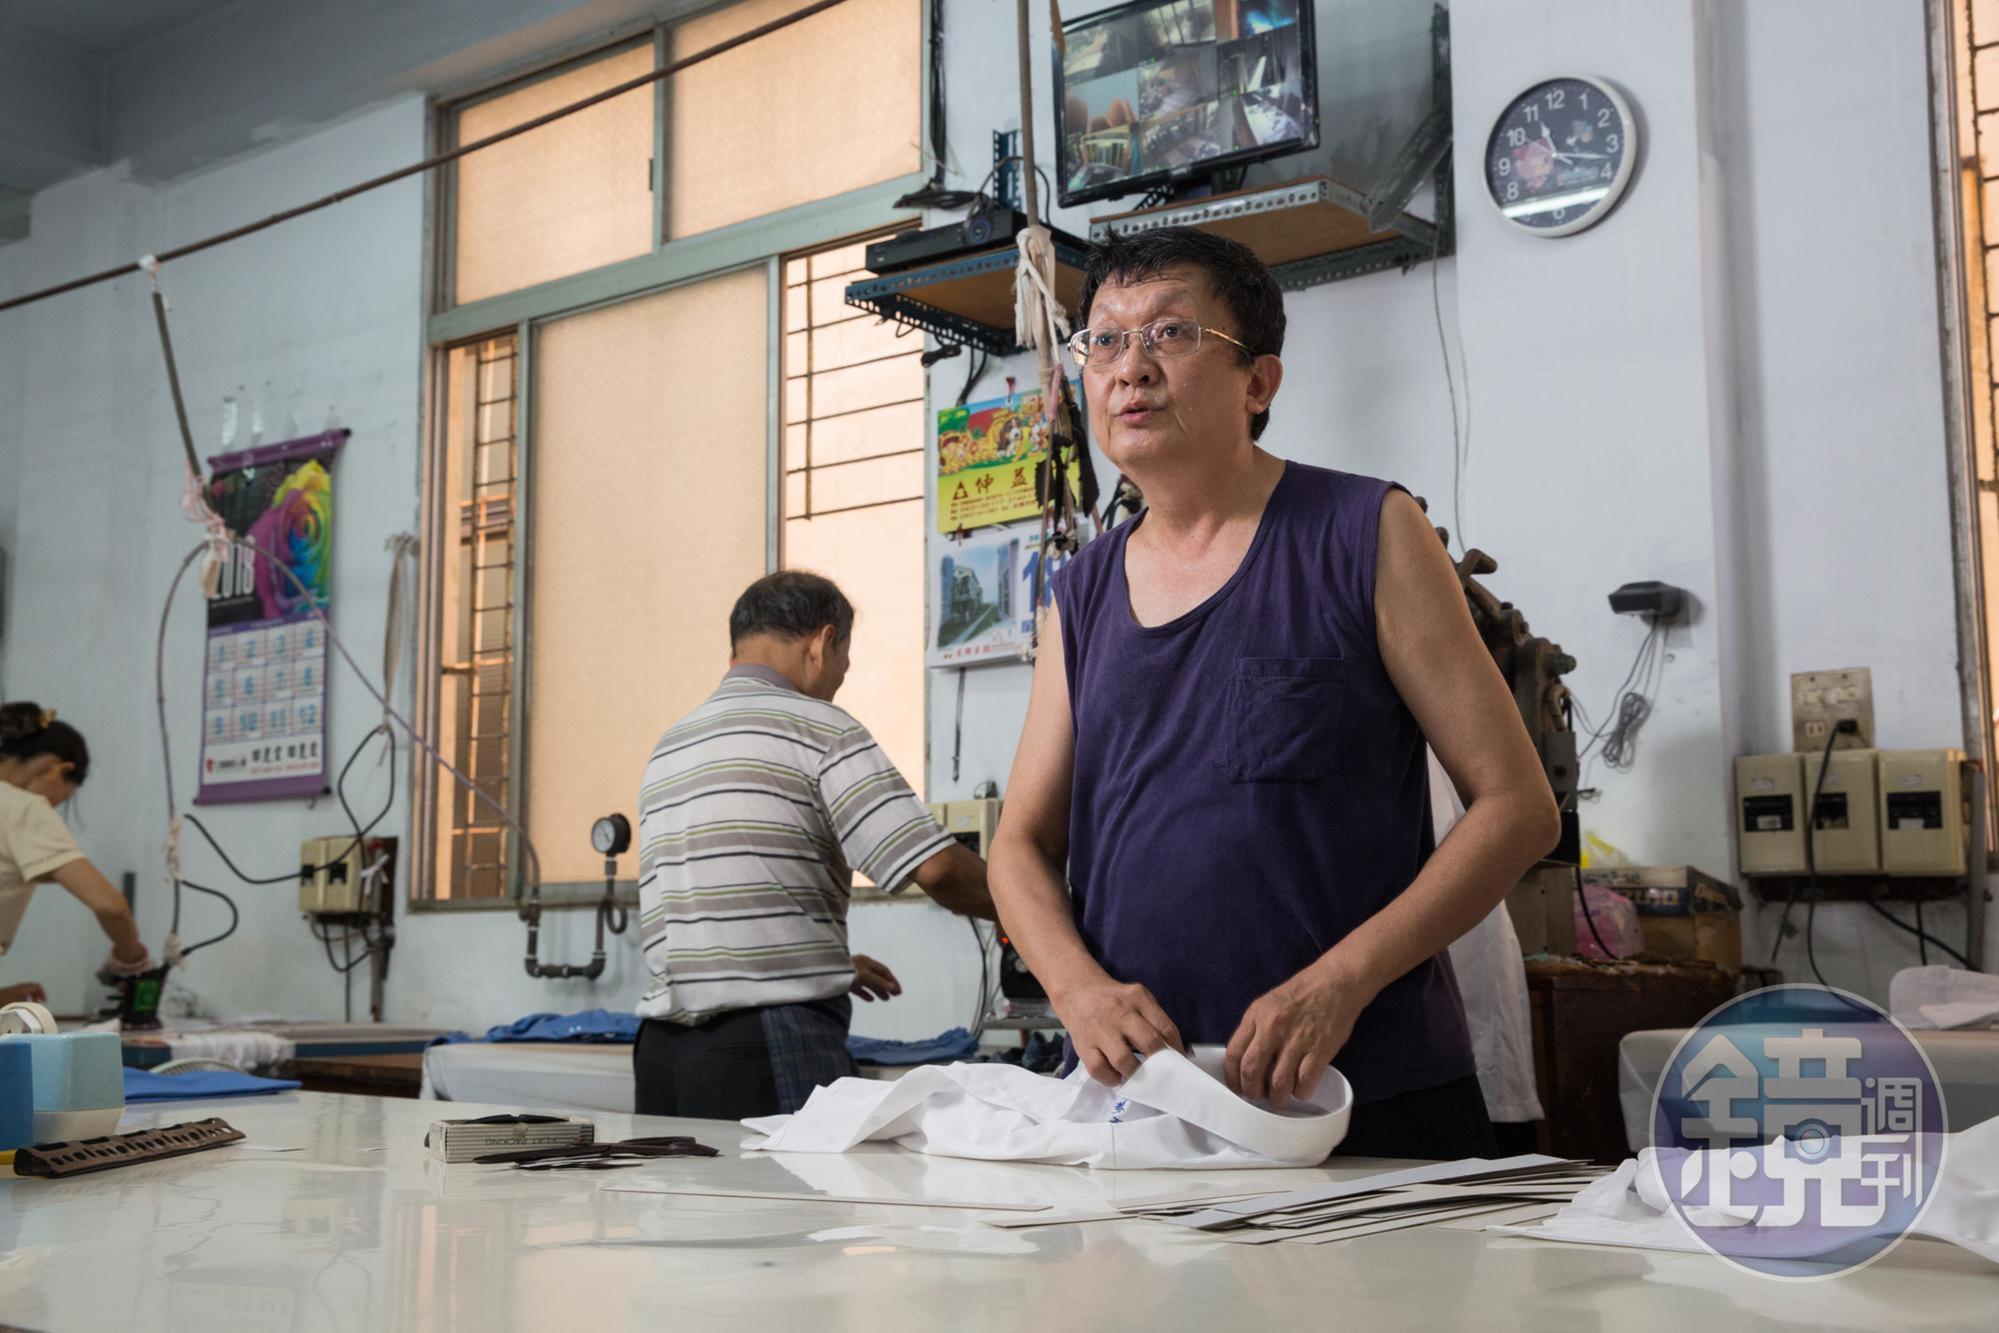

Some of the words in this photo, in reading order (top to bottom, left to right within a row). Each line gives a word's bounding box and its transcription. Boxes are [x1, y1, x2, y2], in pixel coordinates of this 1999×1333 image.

[1545, 89, 1566, 110] 12
[1523, 104, 1539, 123] 11
[1597, 108, 1611, 128] 2
[1506, 127, 1526, 147] 10
[1605, 134, 1619, 153] 3
[1498, 157, 1511, 176] 9
[1600, 162, 1612, 180] 4
[1506, 181, 1519, 200] 8
[207, 533, 256, 599] 018
